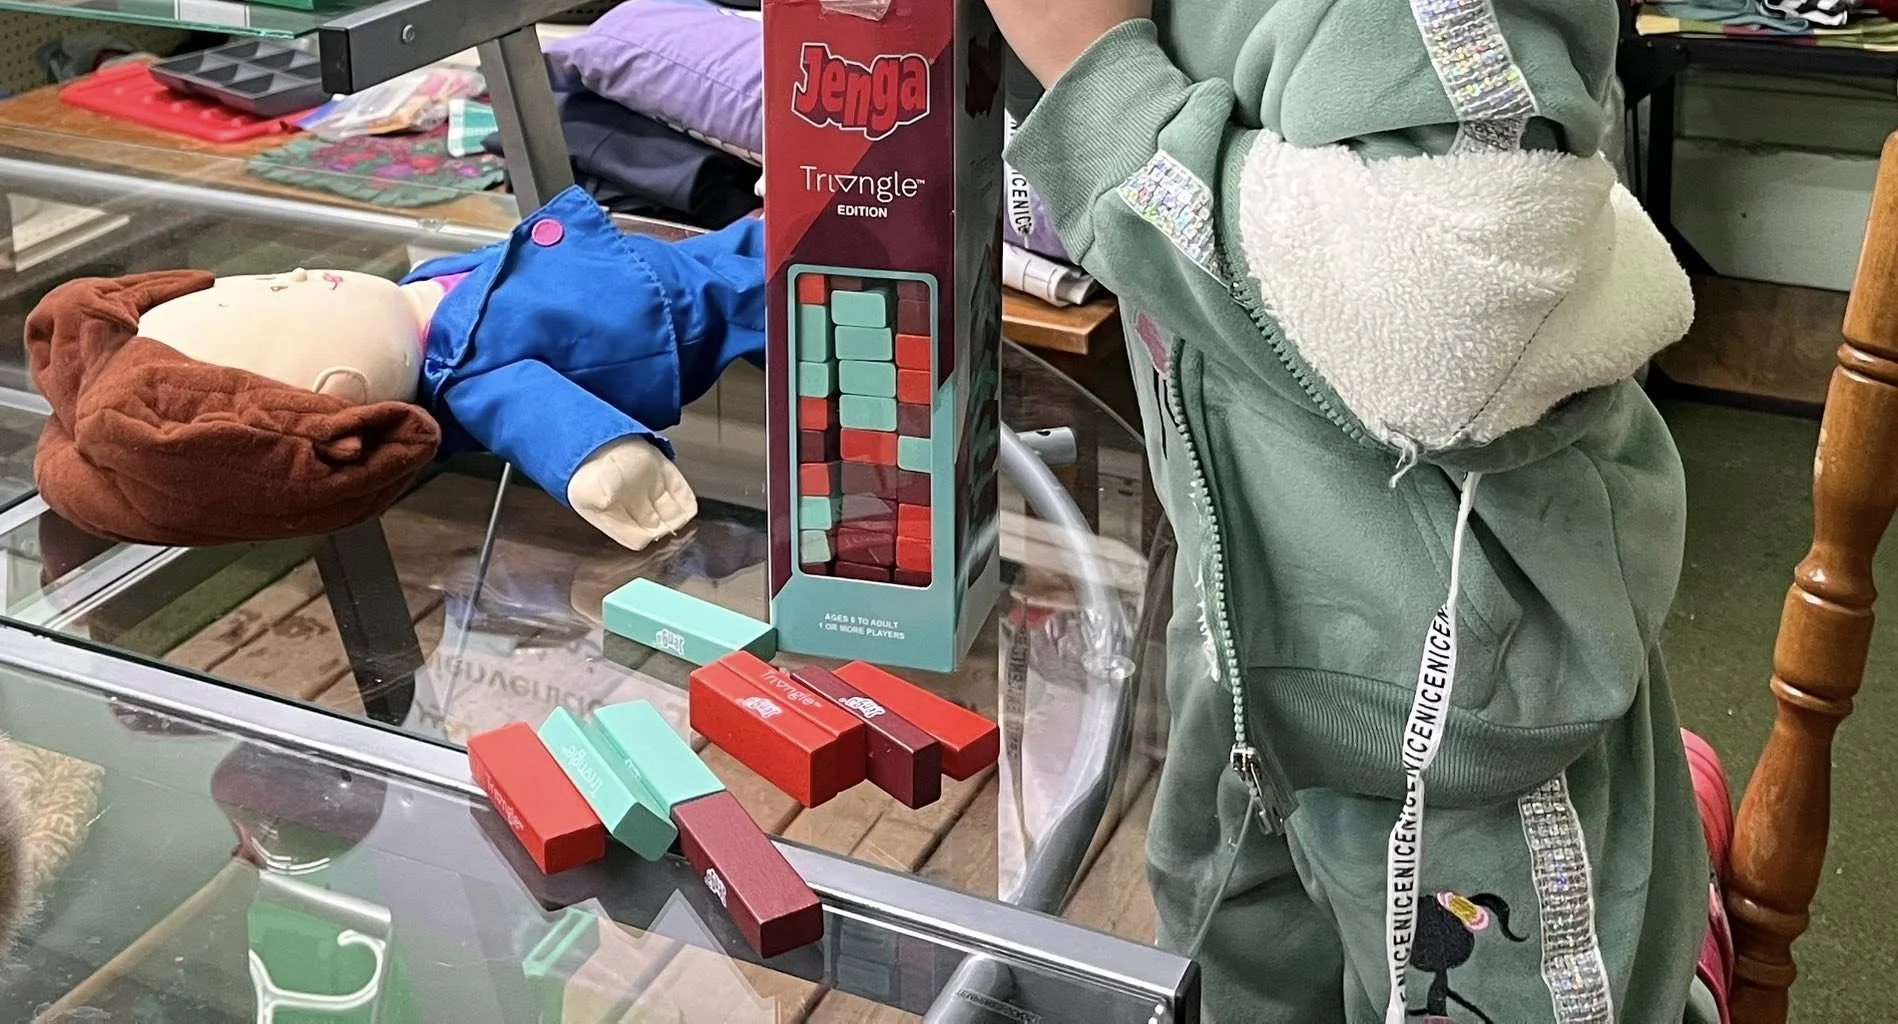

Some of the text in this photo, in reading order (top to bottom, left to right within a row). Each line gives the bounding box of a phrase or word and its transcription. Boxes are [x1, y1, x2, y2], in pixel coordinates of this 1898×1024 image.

[792, 42, 930, 141] Jenga
[837, 204, 888, 218] EDITION
[825, 612, 849, 623] AGES
[857, 616, 869, 626] TO
[870, 619, 899, 628] ADULT
[825, 623, 838, 631] OR
[839, 624, 865, 634] MORE
[866, 627, 905, 640] PLAYERS
